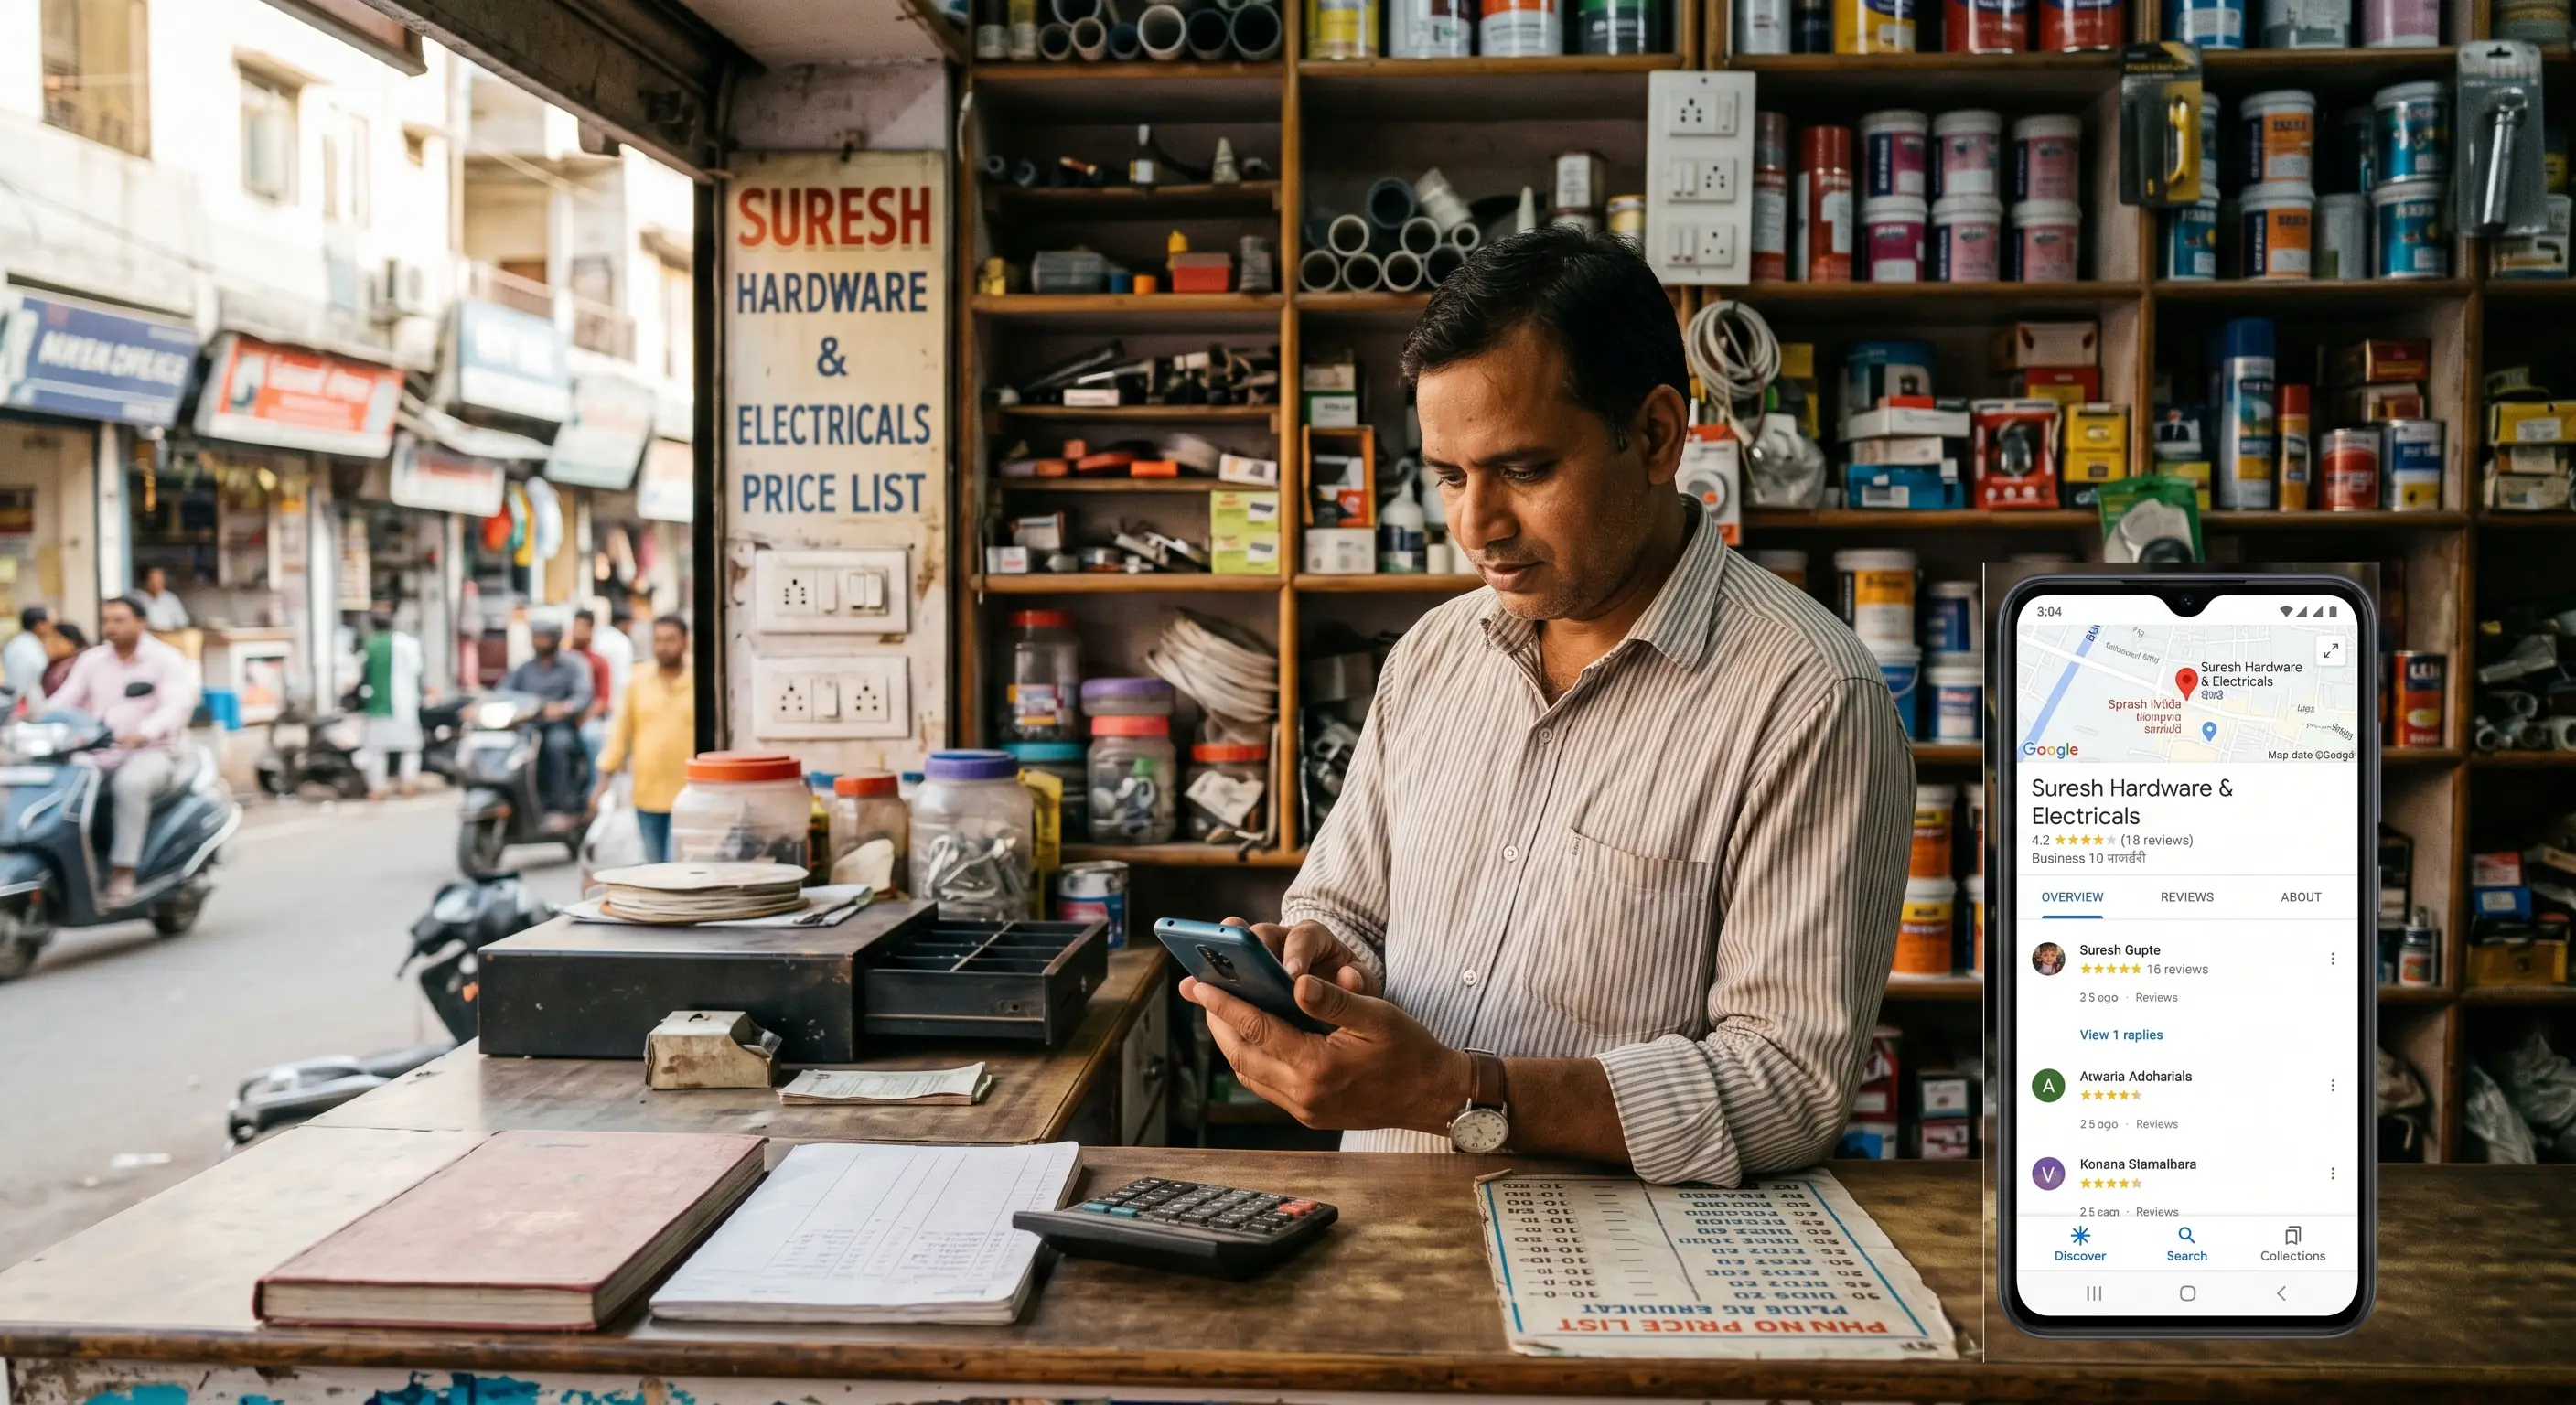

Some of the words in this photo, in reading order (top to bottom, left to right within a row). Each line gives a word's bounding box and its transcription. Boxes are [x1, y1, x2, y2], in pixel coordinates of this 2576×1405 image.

[738, 188, 930, 246] SURESH
[737, 272, 928, 314] HARDWARE
[817, 337, 848, 377] &
[737, 404, 930, 445] ELECTRICALS
[742, 474, 836, 513] PRICE
[852, 473, 926, 512] LIST
[2038, 606, 2062, 617] 3:04
[2202, 661, 2241, 672] Suresh
[2246, 661, 2302, 672] Hardware
[2201, 676, 2209, 686] &
[2213, 676, 2273, 686] Electricals
[2109, 699, 2147, 713] Sprash
[2023, 742, 2078, 758] Google
[2269, 751, 2288, 761] Map
[2292, 750, 2313, 759] date
[2033, 778, 2103, 797] Suresh
[2111, 779, 2212, 797] Hardware
[2219, 778, 2233, 797] &
[2034, 807, 2140, 825] Electricals
[2032, 835, 2049, 845] 4.2
[2121, 834, 2140, 848] (18
[2144, 834, 2193, 847] reviews)
[2033, 853, 2085, 863] Business
[2089, 853, 2103, 863] 10
[2042, 892, 2104, 902] OVERVIEW
[2162, 892, 2214, 902] REVIEWS
[2281, 892, 2322, 902] ABOUT
[2080, 944, 2120, 955] Suresh
[2125, 945, 2161, 958] Gupte
[2148, 964, 2161, 974] 16
[2165, 964, 2208, 974] reviews
[2136, 993, 2177, 1002] Reviews
[2080, 1029, 2109, 1040] View
[2113, 1030, 2118, 1039] 1
[2124, 1029, 2163, 1043] raplies
[2129, 1070, 2192, 1081] Adoharials
[2043, 1078, 2055, 1092] A
[2081, 1120, 2086, 1129] 2
[2137, 1120, 2178, 1129] Reviews
[2081, 1159, 2125, 1169] Konana
[2042, 1167, 2055, 1183] V
[2080, 1207, 2087, 1217] 2
[2137, 1207, 2178, 1217] Reviews
[2055, 1251, 2107, 1260] Discover
[2167, 1251, 2207, 1260] Search
[2261, 1251, 2325, 1260] Collections
[1557, 1319, 1629, 1332] LIST
[1639, 1319, 1742, 1333] PRICE
[1755, 1321, 1806, 1333] NO
[1810, 1321, 1888, 1333] PHN
